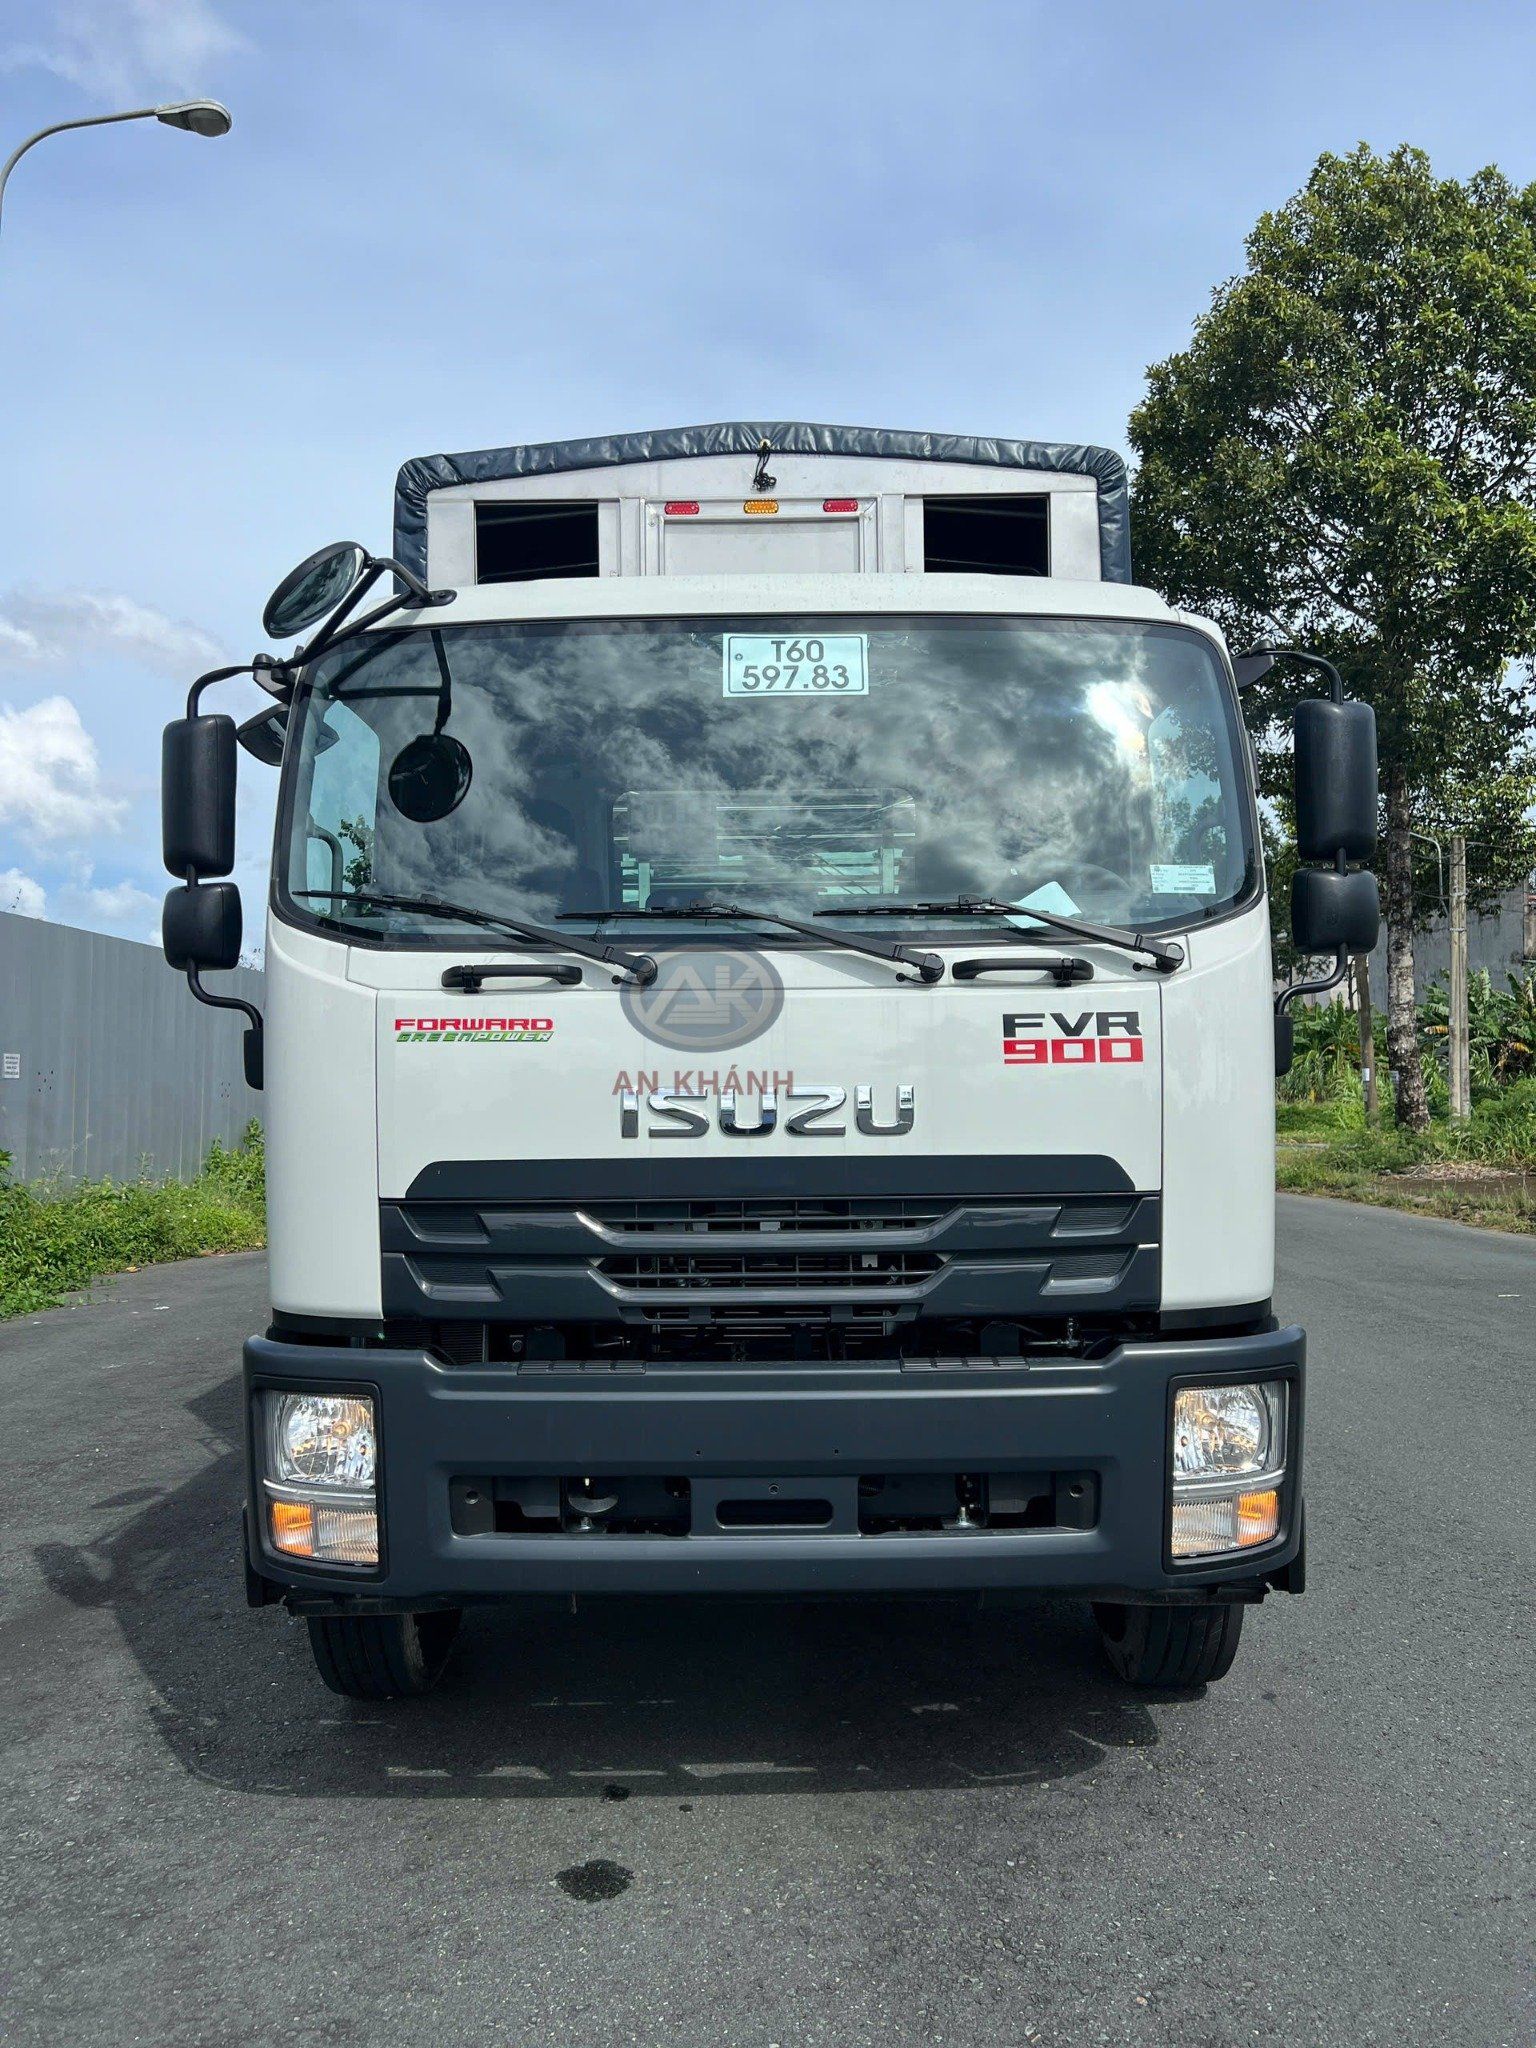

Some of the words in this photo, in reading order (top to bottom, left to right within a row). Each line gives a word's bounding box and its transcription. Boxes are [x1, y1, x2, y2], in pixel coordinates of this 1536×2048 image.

[770, 639, 825, 663] T60
[742, 664, 850, 690] 597.83
[394, 1018, 554, 1031] FORWARD
[1002, 1011, 1143, 1038] FVR
[1003, 1037, 1144, 1064] 900
[620, 1083, 915, 1139] ISUZU
